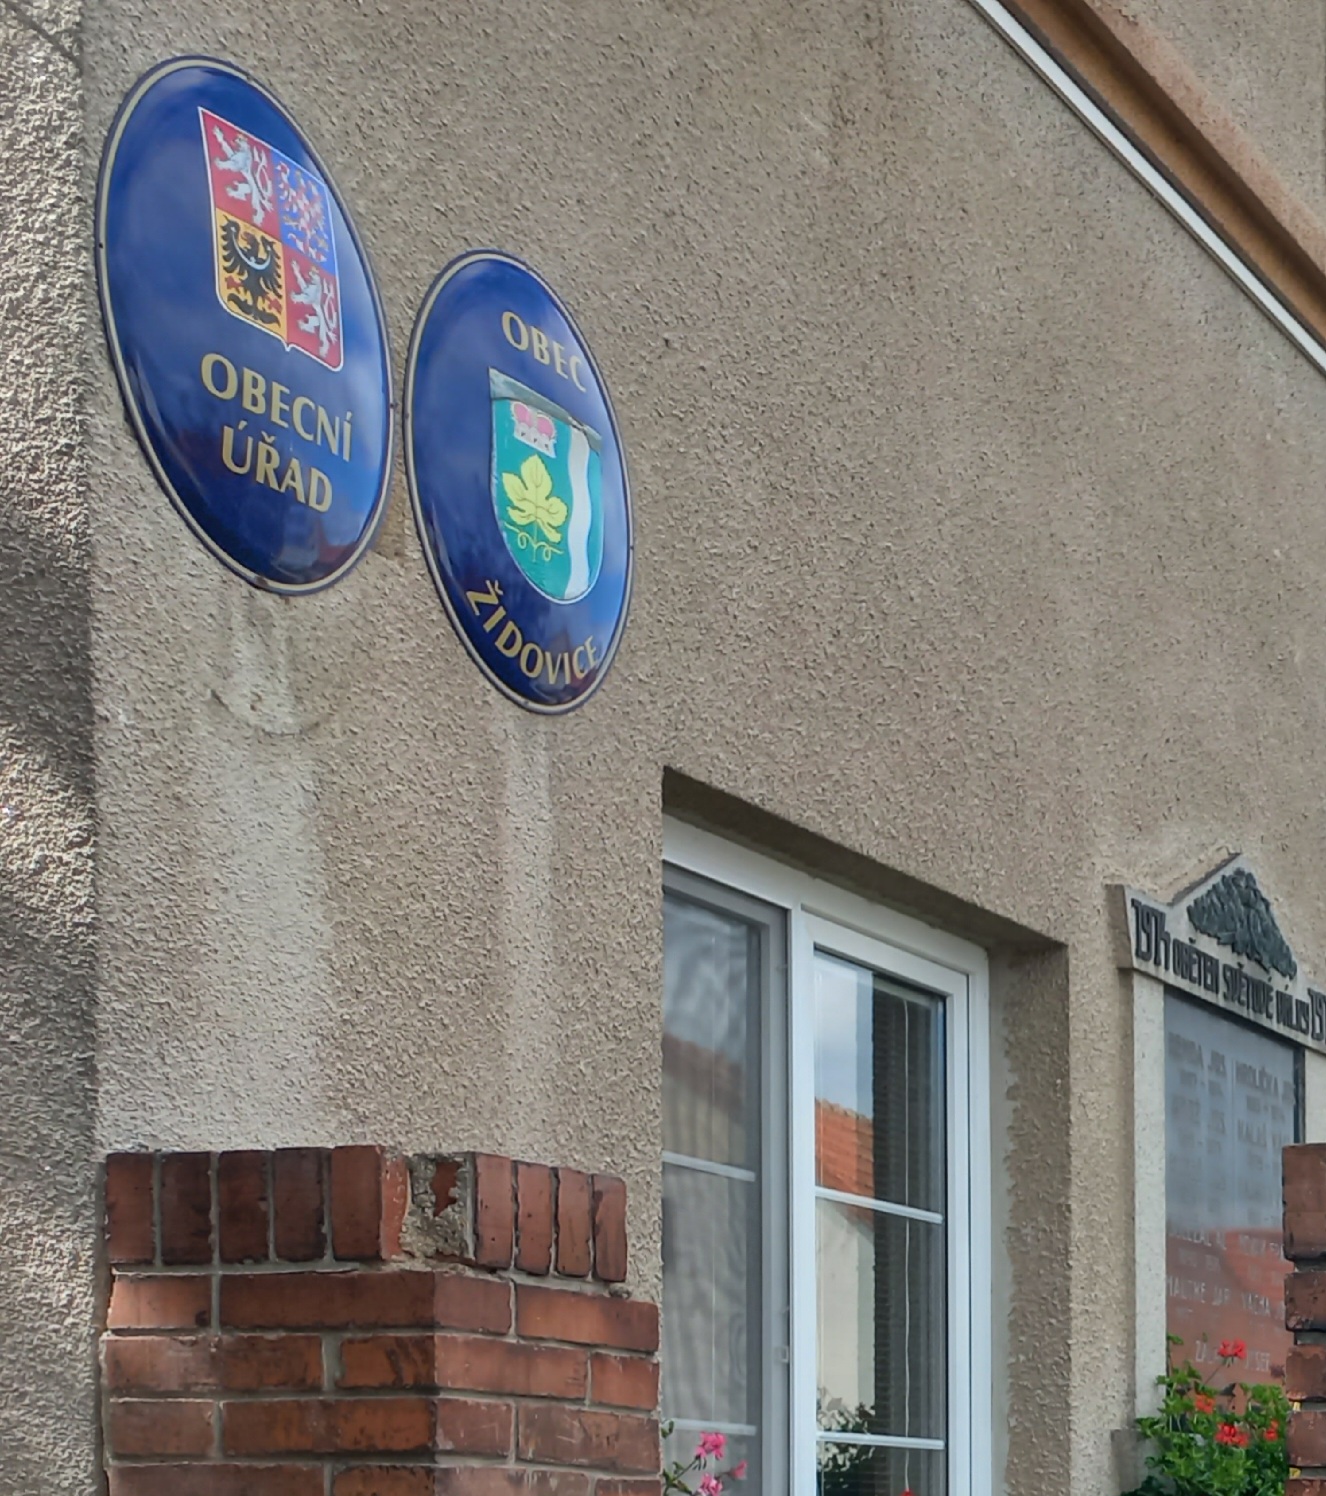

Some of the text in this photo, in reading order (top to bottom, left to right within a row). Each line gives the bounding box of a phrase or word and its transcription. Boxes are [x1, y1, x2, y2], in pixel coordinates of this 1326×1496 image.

[501, 310, 588, 394] OBEC
[201, 352, 353, 463] OBECNÍ
[221, 420, 332, 513] ÚŘAD
[464, 579, 602, 686] ŽIDOVICE
[1131, 898, 1171, 971] 1914
[1223, 962, 1274, 1020] SVĚTOVÉ
